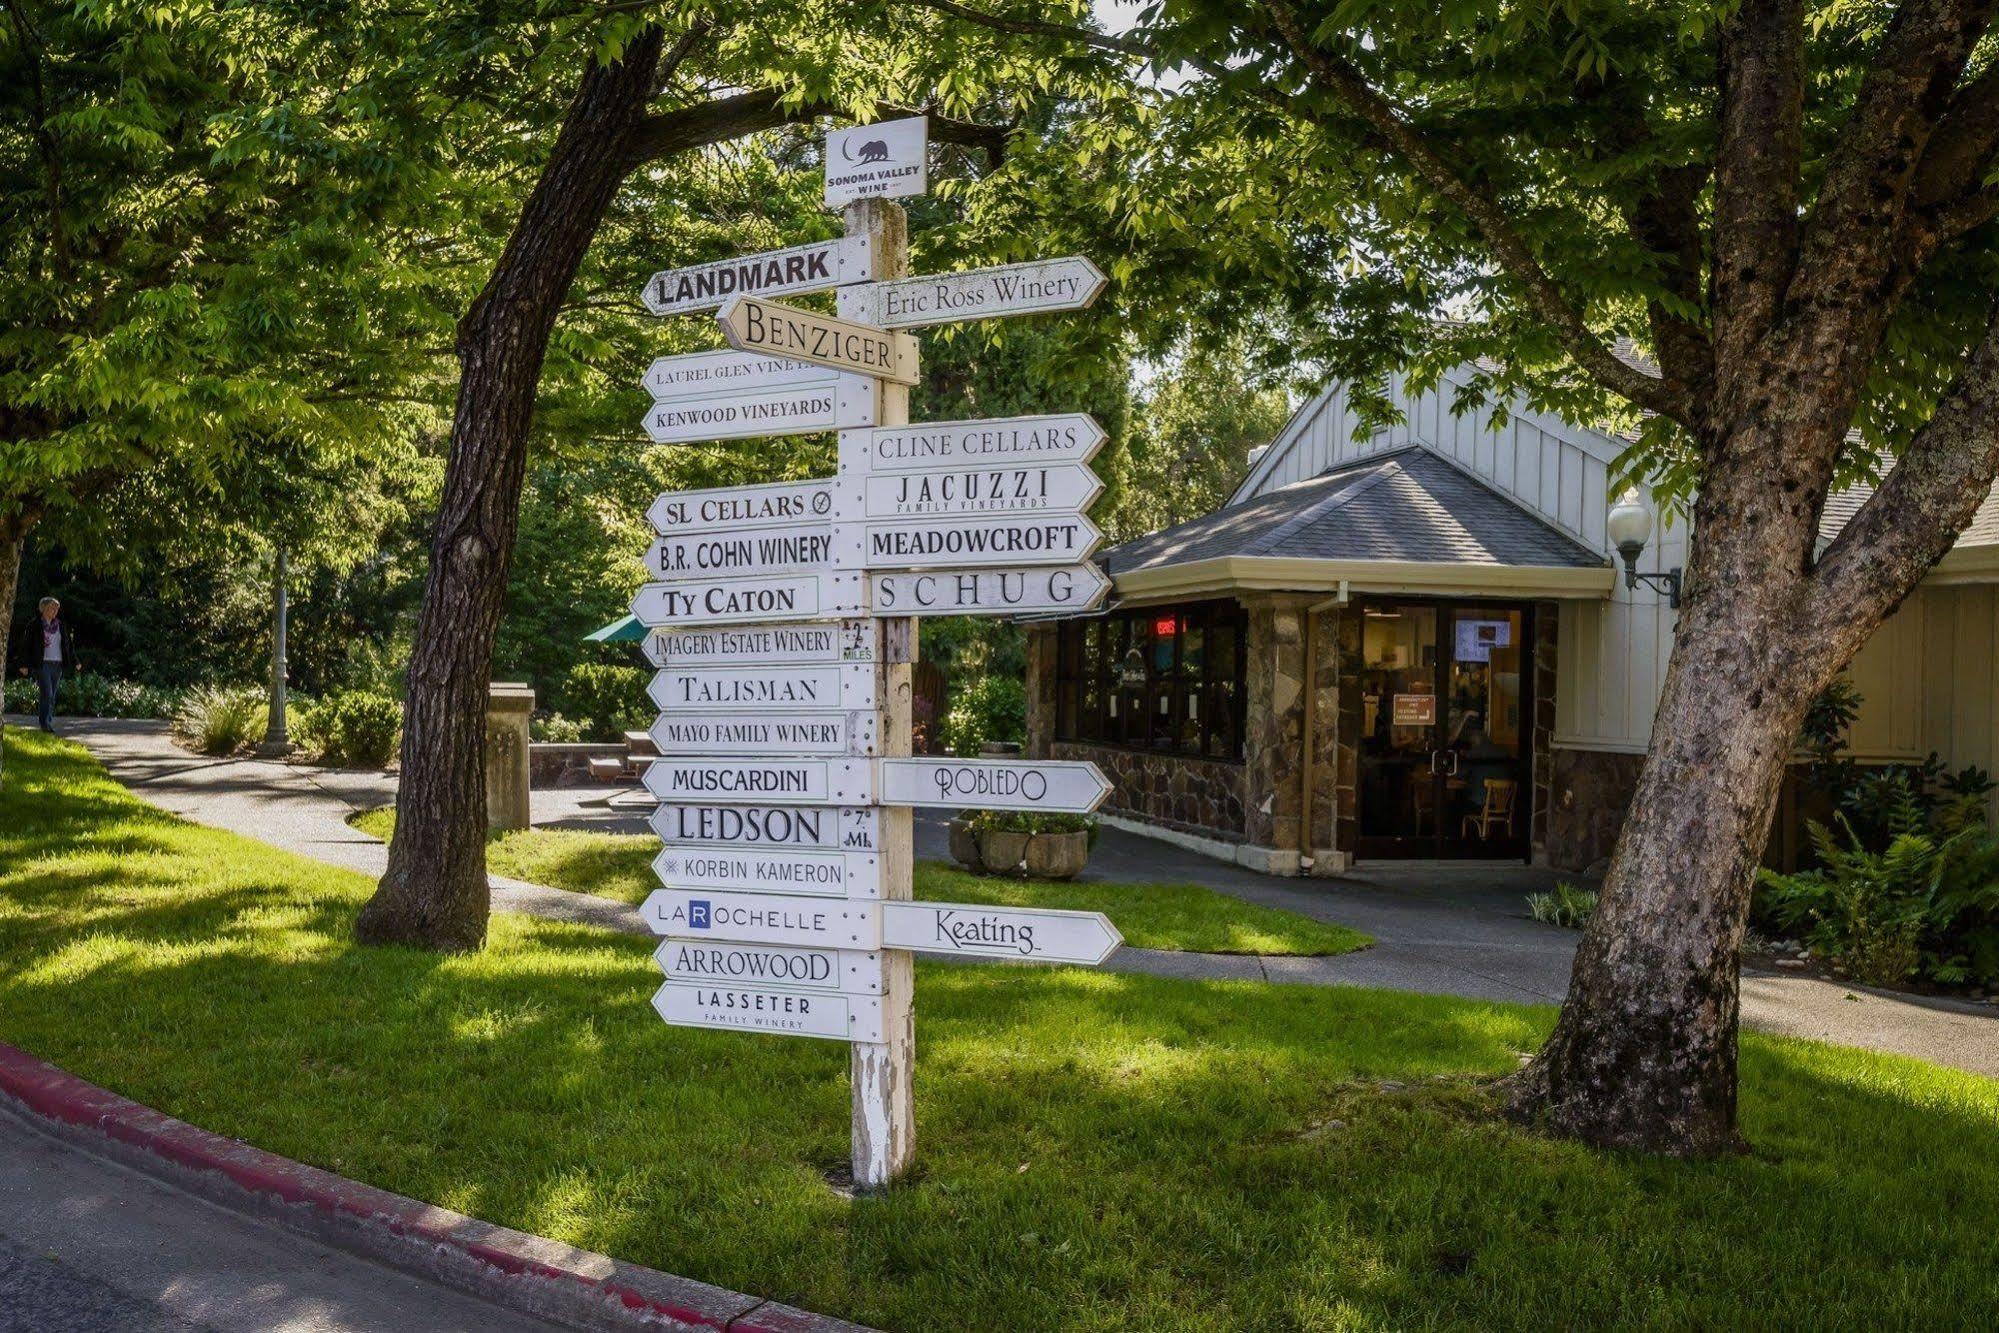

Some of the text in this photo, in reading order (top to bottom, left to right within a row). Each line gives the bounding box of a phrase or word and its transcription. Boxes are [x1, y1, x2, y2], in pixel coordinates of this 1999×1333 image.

[828, 172, 875, 187] SONOMA
[877, 166, 920, 180] VALLEY
[858, 183, 888, 194] WINE
[658, 251, 830, 304] LANDMARK
[886, 276, 1079, 316] Eric Ross Winery
[746, 303, 892, 368] BENZIGER
[656, 367, 713, 385] LAUREL
[715, 363, 752, 379] GLEN
[656, 397, 831, 428] KENWOOD VINEYARDS
[879, 427, 1076, 459] CLINE CELLARS
[896, 470, 1048, 503] JACUZZI
[666, 503, 692, 525] SL
[701, 495, 804, 522] CELLARS
[897, 498, 1048, 513] FAMILY VINEYARDS
[660, 534, 831, 571] B.R. COHN WINERY
[872, 525, 1078, 556] MEADOWCROFT
[705, 587, 796, 614] CATON
[879, 570, 1073, 607] SCHUG
[655, 630, 833, 656] IMAGERY ESTATE WINERY
[843, 650, 872, 661] MILES
[678, 677, 818, 701] TALISMAN
[668, 725, 840, 743] MAYO FAMILY WINERY
[672, 769, 808, 792] MUSCARDINI
[934, 767, 1047, 800] ROBLEDO
[677, 807, 822, 844] LEDSON
[855, 810, 864, 825] 7
[685, 859, 842, 884] KORBIN KAMERON
[935, 910, 1034, 954] Keating
[675, 946, 830, 981] ARROWOOD
[698, 990, 810, 1014] LASSETER
[704, 1014, 803, 1029] FAMILY WINERY
